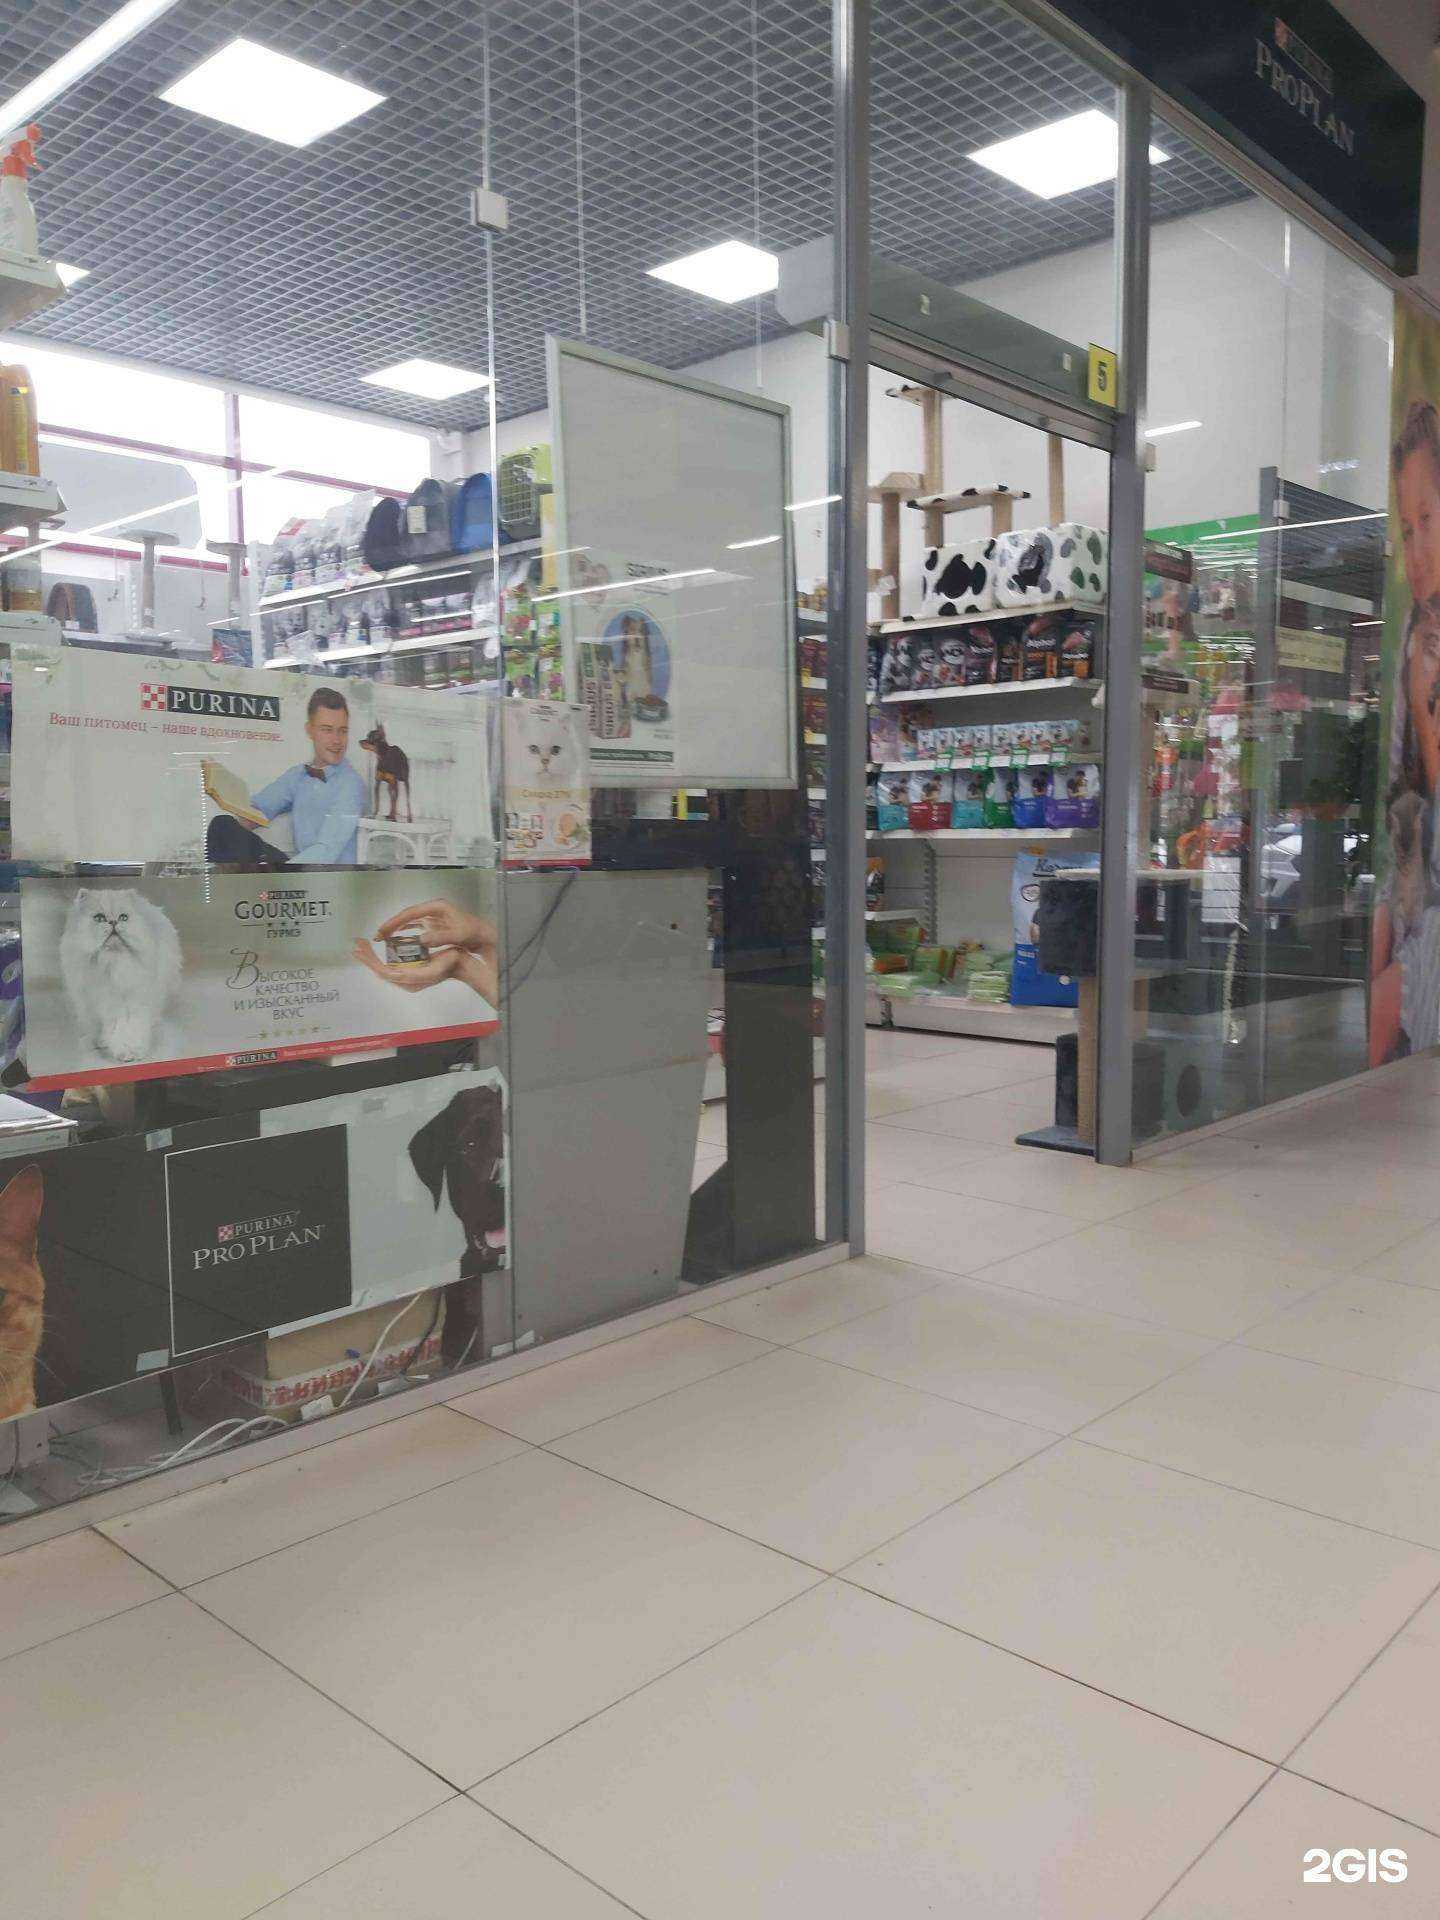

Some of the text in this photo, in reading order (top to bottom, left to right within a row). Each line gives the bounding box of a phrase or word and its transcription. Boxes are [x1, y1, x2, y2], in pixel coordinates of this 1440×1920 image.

[172, 690, 277, 718] PURINA
[49, 712, 80, 727] Ваш
[83, 716, 148, 733] питомец
[162, 722, 197, 736] наше
[234, 900, 330, 920] GOURMET
[256, 980, 320, 996] КАЧЕСТВО
[233, 989, 340, 1011] И ИЗЫСКАННЫЙ
[272, 1006, 305, 1020] ВКУС
[236, 1051, 277, 1065] PURINA
[235, 1214, 293, 1236] PURINA
